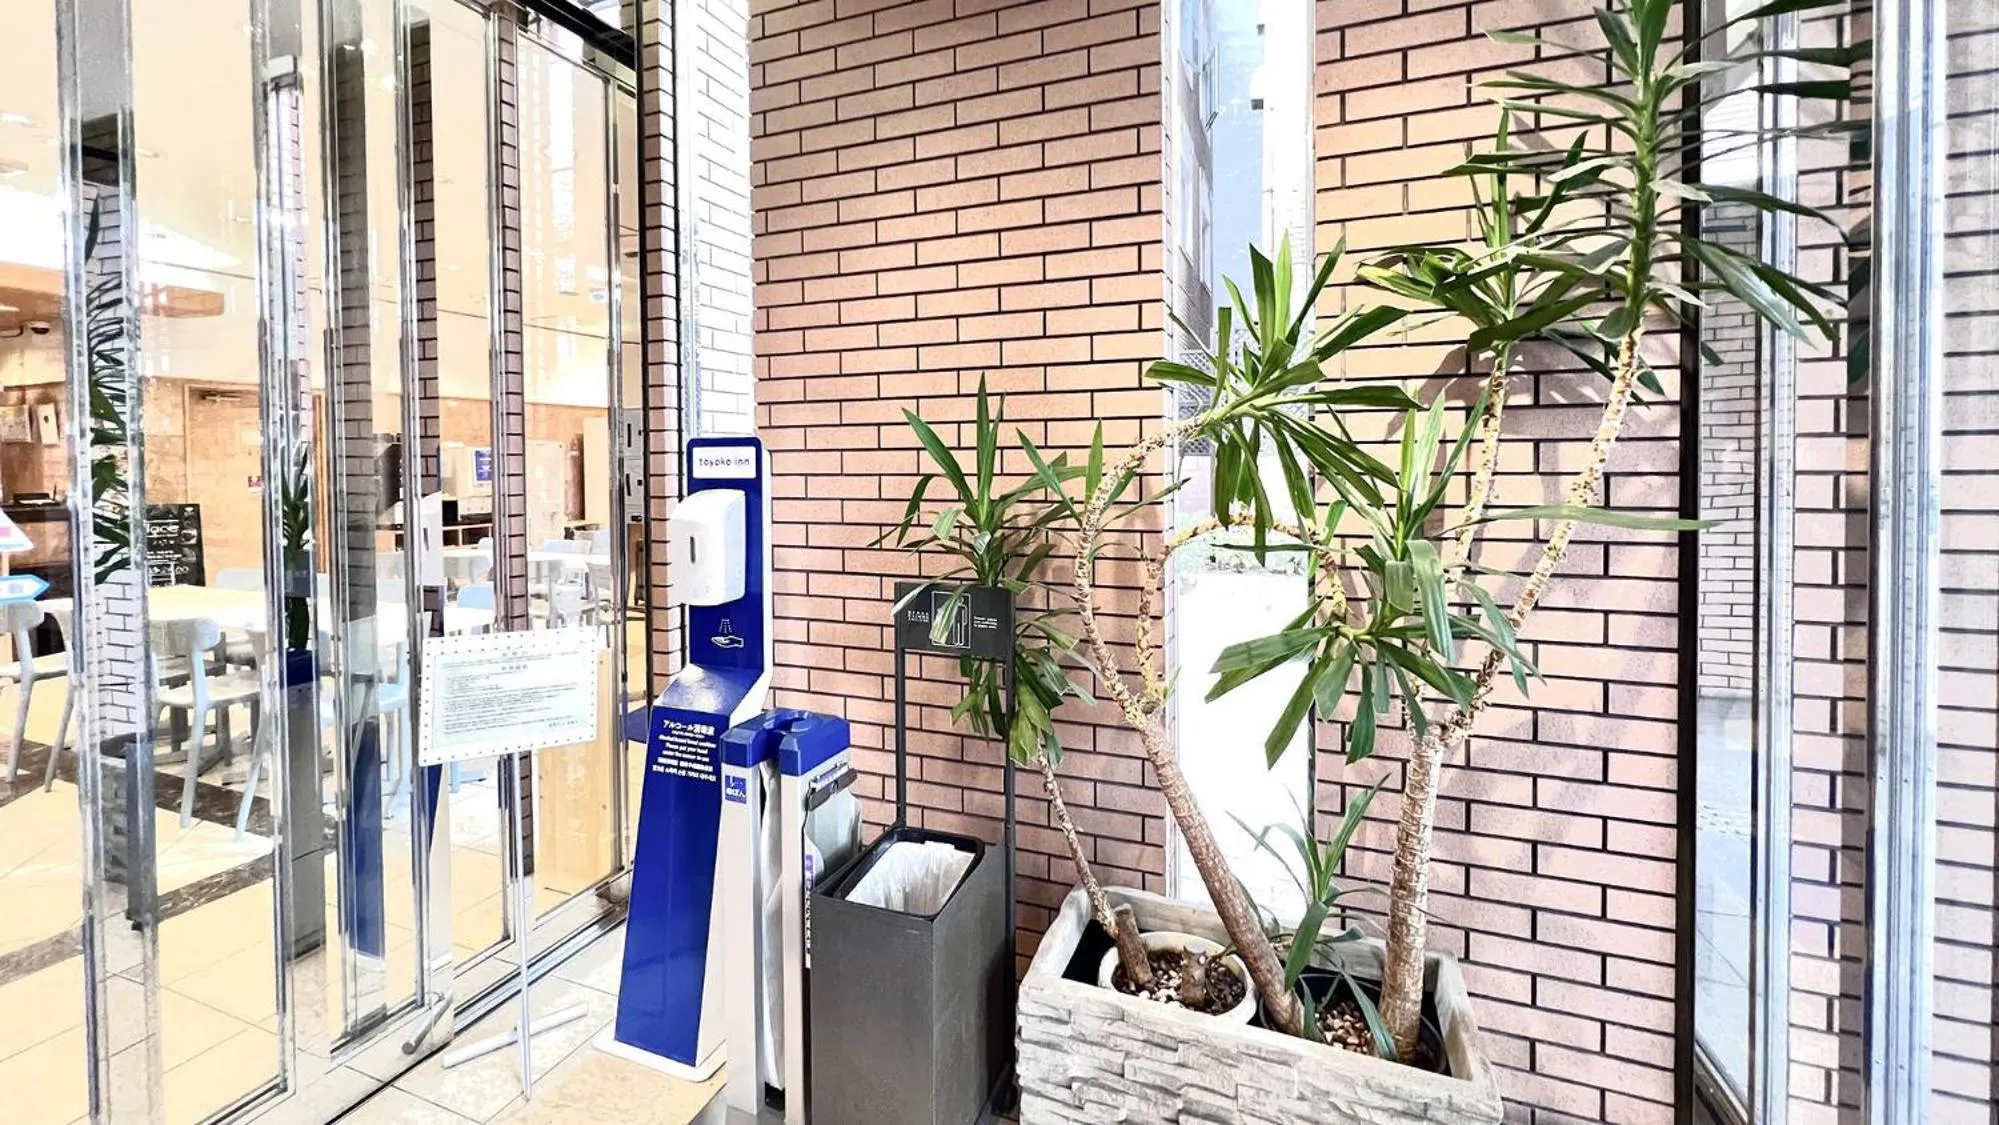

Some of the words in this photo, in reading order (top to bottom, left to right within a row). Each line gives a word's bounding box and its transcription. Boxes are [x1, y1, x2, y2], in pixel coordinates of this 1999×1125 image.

[699, 457, 731, 468] toyoko
[734, 456, 750, 466] inn
[665, 742, 679, 750] Please
